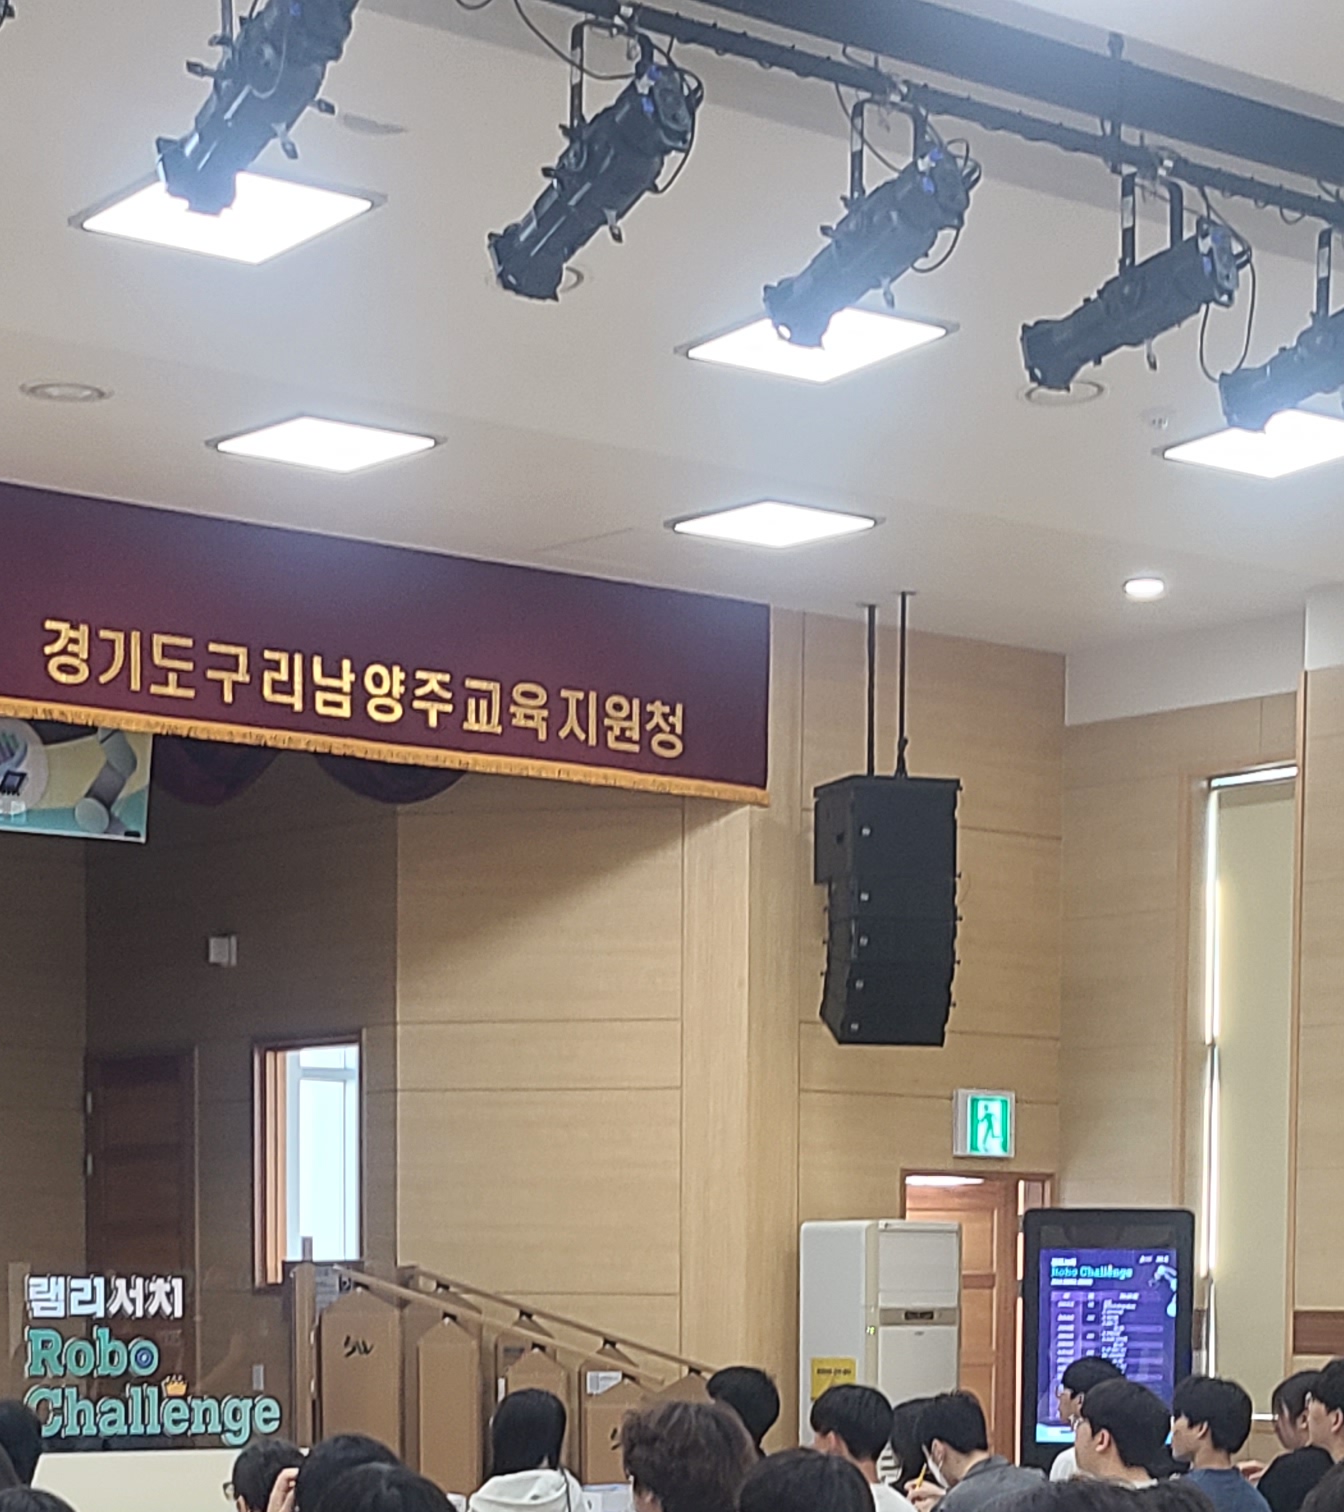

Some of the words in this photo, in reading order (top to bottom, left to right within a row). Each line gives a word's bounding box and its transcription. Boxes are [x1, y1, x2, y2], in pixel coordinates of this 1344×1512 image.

[43, 618, 685, 759] 경기도구리남양주교육지원청
[26, 1275, 183, 1319] 램리서치
[26, 1326, 159, 1377] Robo
[25, 1384, 281, 1446] Challenge
